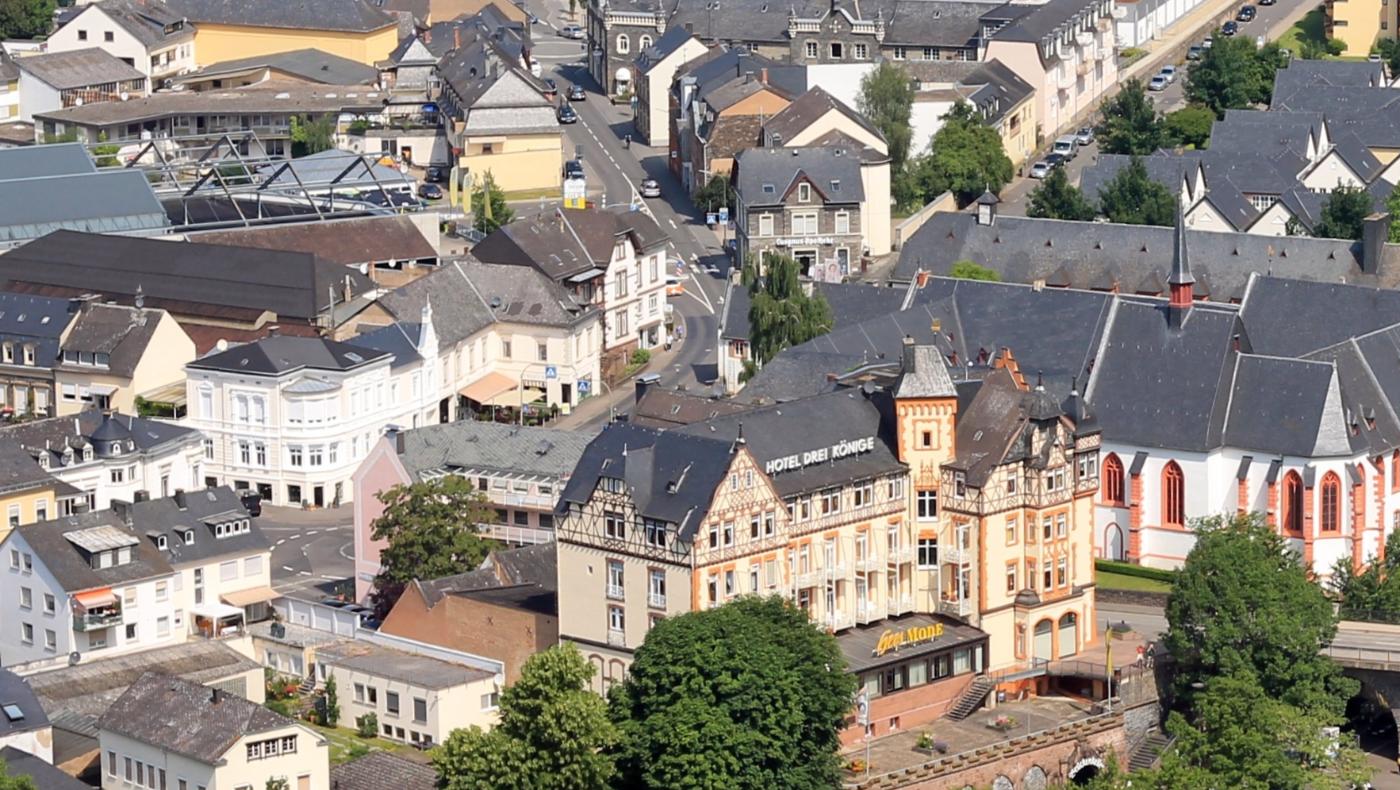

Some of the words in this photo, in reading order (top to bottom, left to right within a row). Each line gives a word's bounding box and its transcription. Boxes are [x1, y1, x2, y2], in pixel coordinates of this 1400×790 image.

[765, 455, 802, 474] HOTEL
[803, 447, 829, 465] DREI
[831, 437, 875, 458] KÖNIGE
